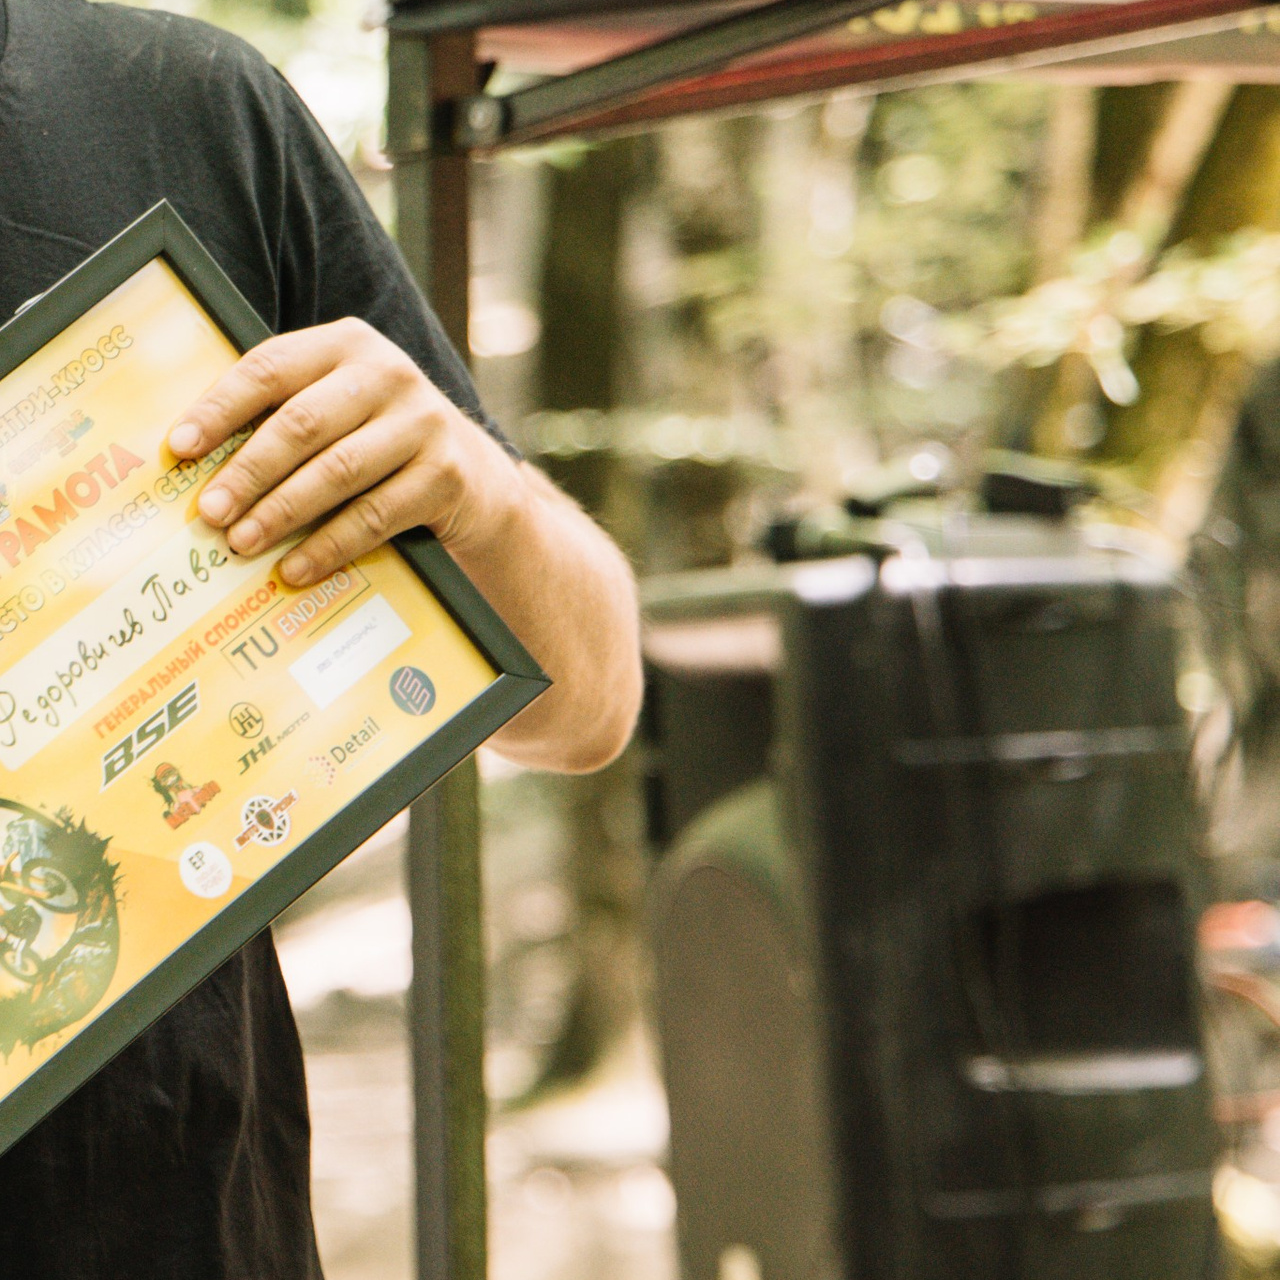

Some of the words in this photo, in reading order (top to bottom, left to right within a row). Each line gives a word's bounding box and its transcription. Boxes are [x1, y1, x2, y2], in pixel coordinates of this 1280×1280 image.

[41, 567, 66, 594] В
[59, 493, 160, 580] КЛАССЕ
[136, 540, 238, 621] Паве
[93, 639, 207, 738] ГЕНЕРАЛЬНЫЙ
[204, 580, 279, 648] СПОНСОР
[231, 628, 281, 673] TU
[281, 570, 352, 635] ENDURO
[102, 680, 199, 788] BSE
[330, 717, 380, 764] Detail
[188, 850, 207, 872] EP
